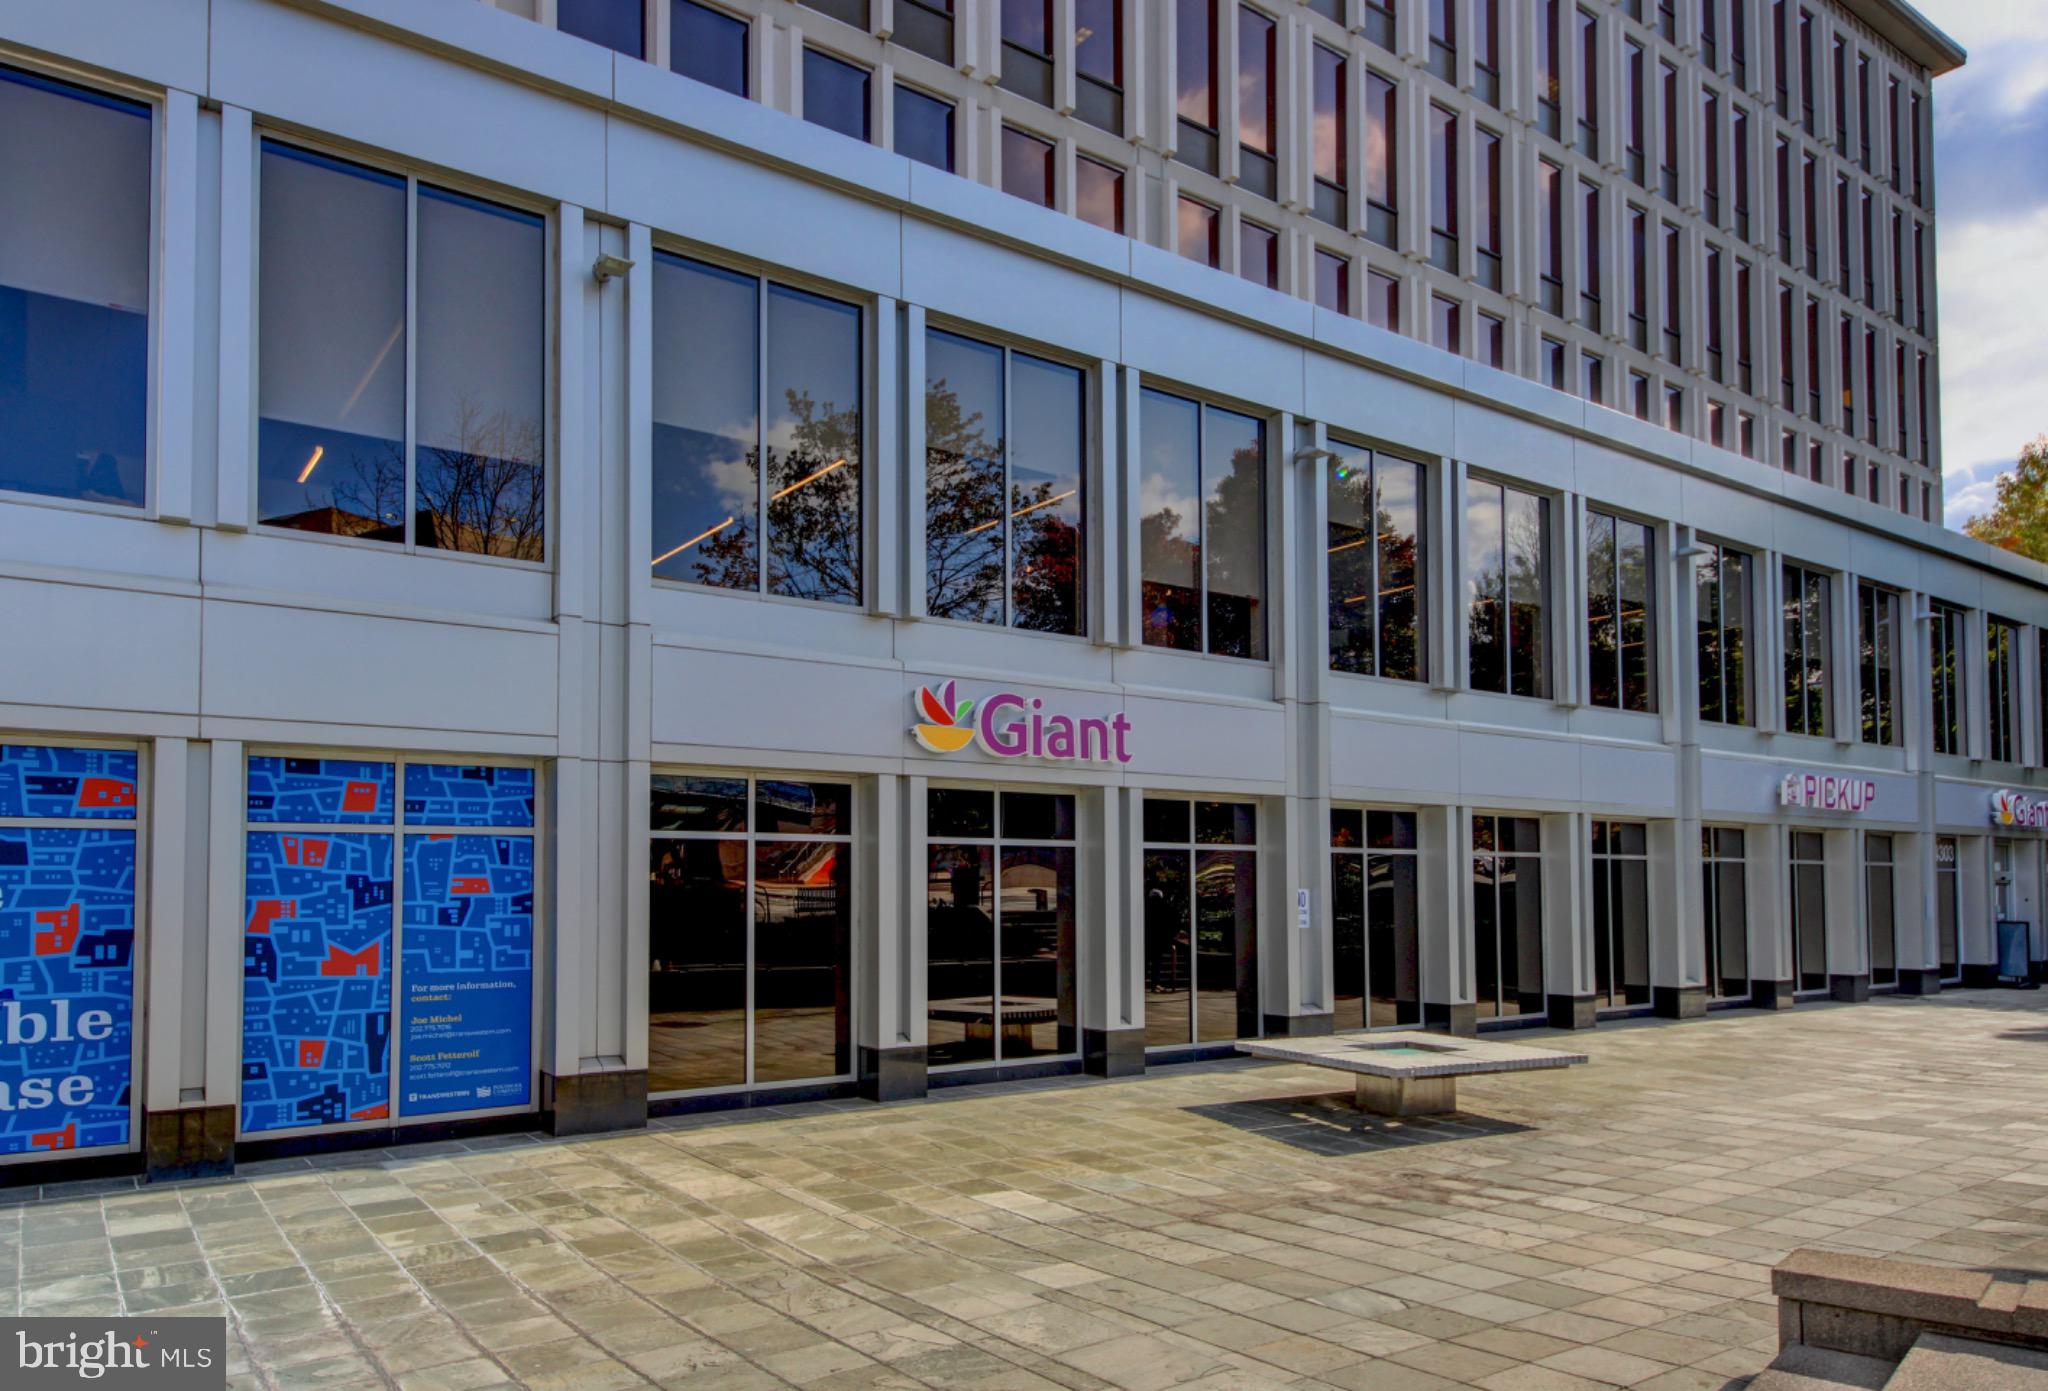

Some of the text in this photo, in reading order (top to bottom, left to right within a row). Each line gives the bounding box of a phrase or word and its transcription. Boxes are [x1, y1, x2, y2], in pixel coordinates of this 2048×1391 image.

[977, 693, 1133, 763] Giant
[1803, 774, 1876, 811] PICKUP
[411, 981, 517, 993] For more information,
[410, 993, 452, 1002] contact:
[411, 1013, 463, 1025] Joe Michel
[409, 1049, 480, 1063] Scott Fetterolf
[418, 1090, 470, 1100] TRANSWESTERN
